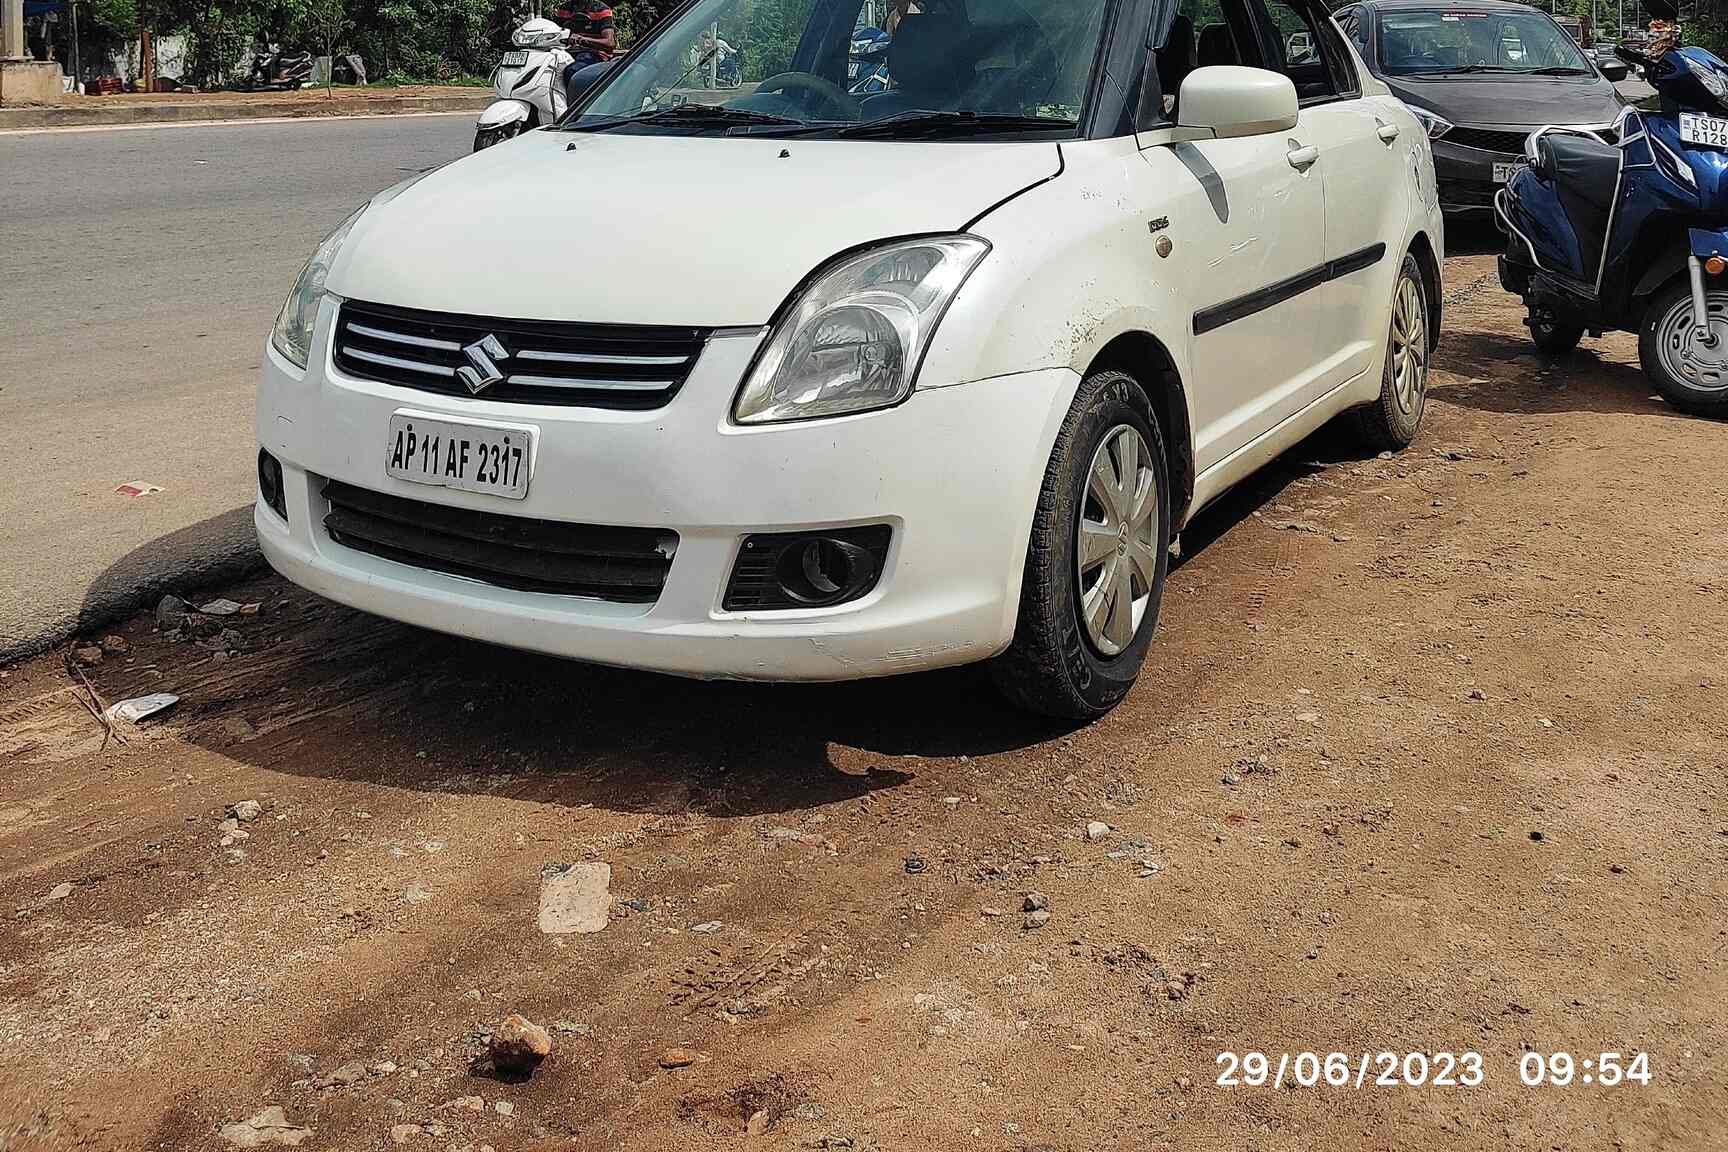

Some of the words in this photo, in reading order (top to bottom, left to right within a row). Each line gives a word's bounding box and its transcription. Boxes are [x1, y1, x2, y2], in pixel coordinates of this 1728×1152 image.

[1691, 117, 1727, 133] TS07
[1692, 129, 1728, 146] R128
[391, 430, 417, 470] AP
[421, 434, 440, 475] 11
[444, 438, 471, 479] AF
[476, 442, 523, 488] 2317
